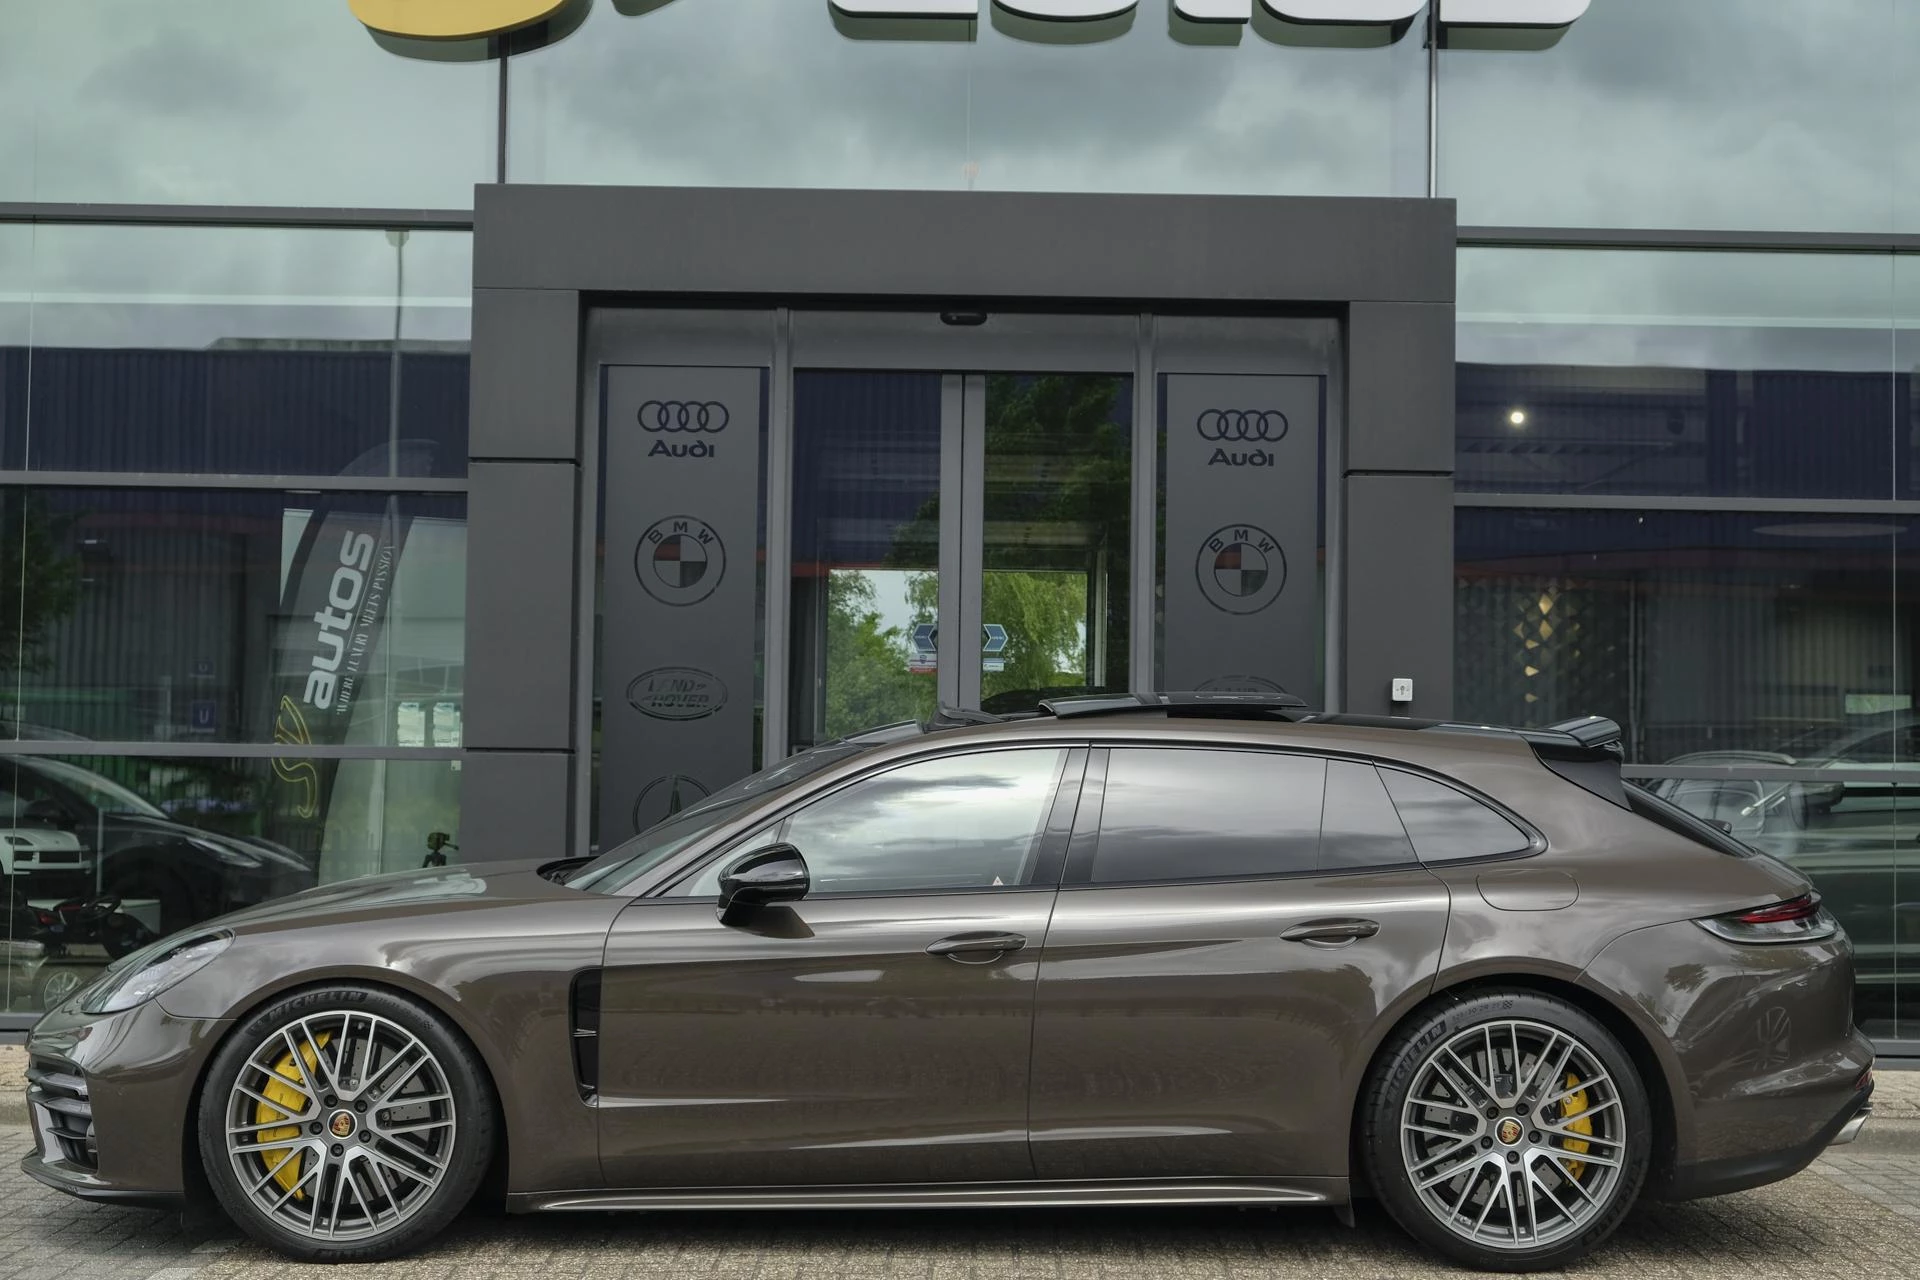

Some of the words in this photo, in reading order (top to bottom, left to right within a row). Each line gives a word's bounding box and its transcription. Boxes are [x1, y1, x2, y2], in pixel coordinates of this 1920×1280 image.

[647, 439, 715, 458] Audi
[1207, 448, 1275, 467] Audi
[647, 521, 715, 545] BMW
[1207, 529, 1275, 554] BMW
[302, 529, 376, 710] autos
[647, 679, 697, 692] LAND
[651, 694, 710, 708] ROVER
[268, 991, 364, 1020] MICHELIN
[1386, 1023, 1445, 1104] MICHELIN
